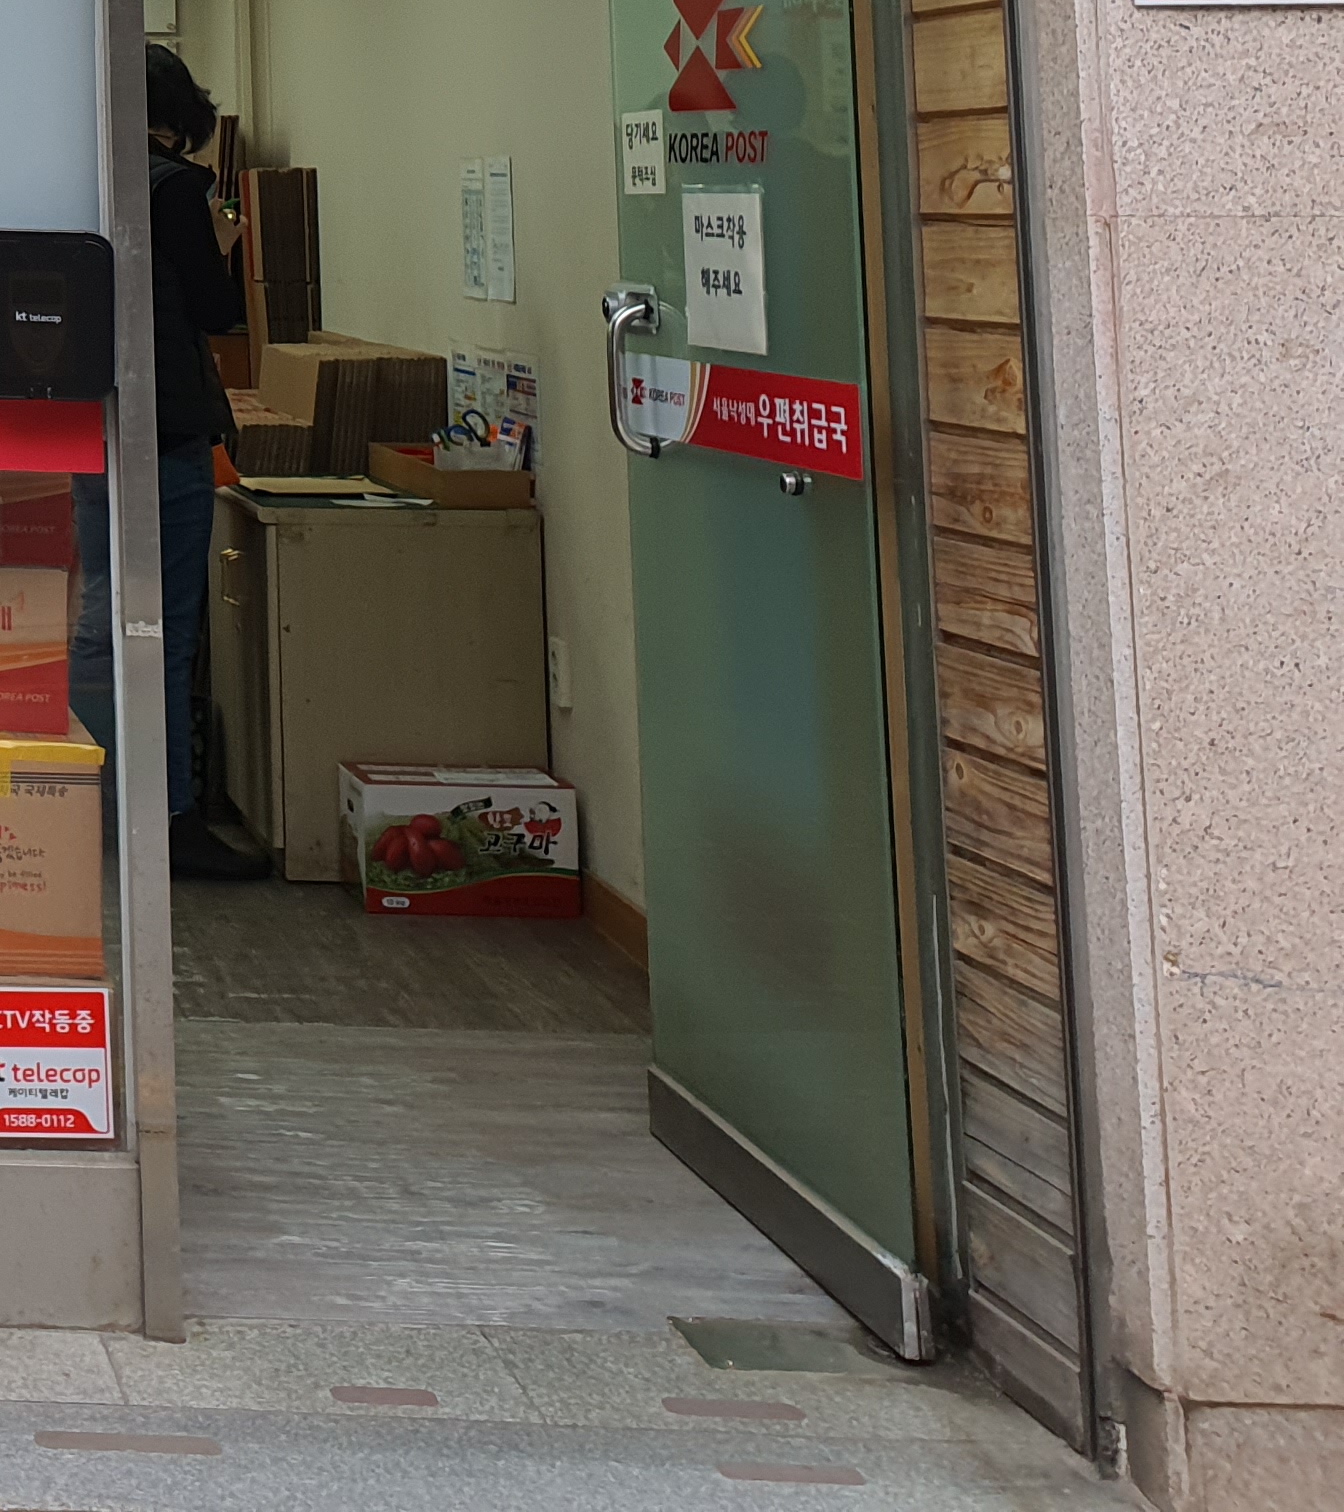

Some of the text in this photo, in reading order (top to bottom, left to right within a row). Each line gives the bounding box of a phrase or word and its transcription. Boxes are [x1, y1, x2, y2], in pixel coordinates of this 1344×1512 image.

[626, 121, 659, 150] 당기세요
[668, 131, 769, 164] KOREA POST
[631, 165, 656, 187] 문턱조심
[694, 214, 746, 249] 마스크착용
[701, 267, 742, 297] 해주세요
[15, 311, 28, 322] kt
[757, 393, 849, 454] 우편취급국
[25, 693, 50, 703] POST
[480, 832, 558, 855] 고구마
[11, 1062, 101, 1088] telecop
[8, 1088, 69, 1100] 케이티텔레캅
[3, 1114, 75, 1128] 1588-0112
